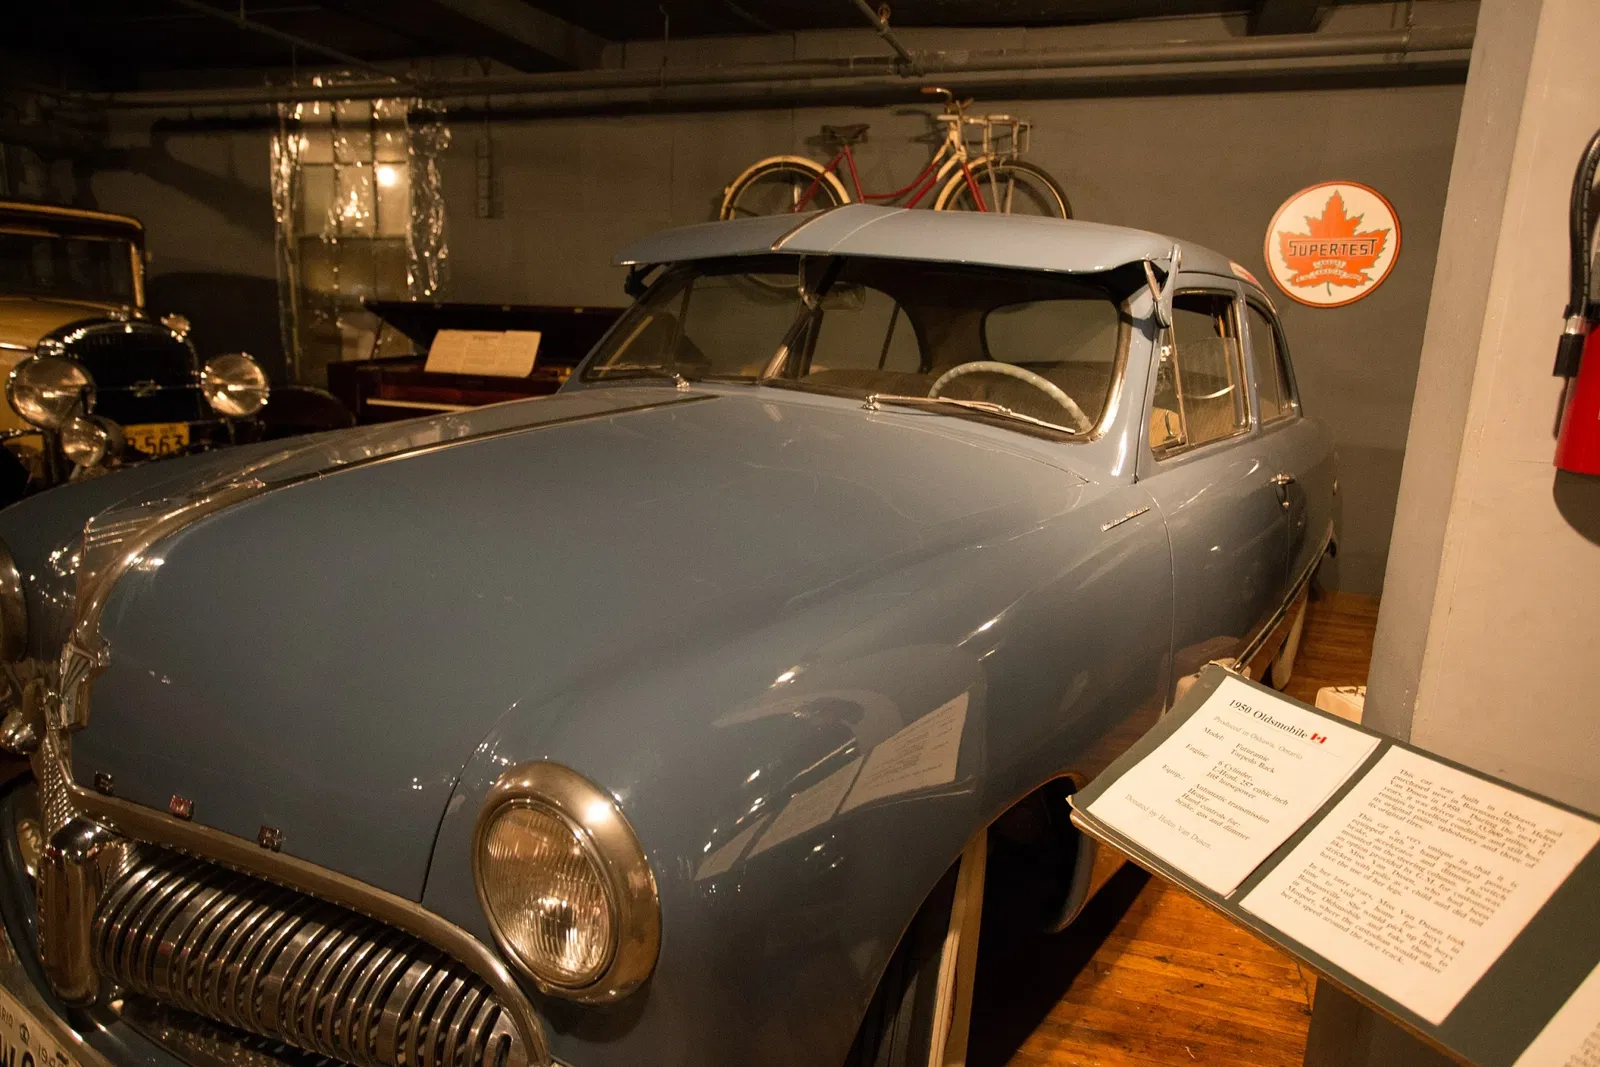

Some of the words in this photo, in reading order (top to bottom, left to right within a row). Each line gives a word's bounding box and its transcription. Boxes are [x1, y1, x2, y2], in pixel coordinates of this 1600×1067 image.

[1288, 239, 1377, 257] SUPERTEST
[1229, 699, 1252, 713] 1950
[1252, 709, 1307, 738] Oldsmobile
[1204, 726, 1224, 741] Model:
[1213, 716, 1242, 732] Produced
[1278, 746, 1302, 759] Ontario
[1185, 743, 1209, 758] Engine:
[1230, 748, 1256, 764] Torpedo
[1257, 761, 1274, 773] Back
[1235, 743, 1269, 761] Futuramic
[1187, 787, 1209, 801] Heater
[1218, 777, 1256, 798] horsepower
[1239, 779, 1253, 787] 257
[1252, 787, 1271, 797] cubic
[1272, 794, 1288, 805] inch
[1181, 792, 1200, 805] Hand
[1199, 804, 1226, 819] controls
[1226, 817, 1240, 827] for:
[1194, 783, 1226, 802] Automatic
[1227, 800, 1269, 823] transmission
[1125, 794, 1149, 811] Donated
[1149, 809, 1157, 817] by
[1158, 814, 1175, 828] Helen
[1178, 825, 1189, 836] Van
[1208, 817, 1223, 826] and
[1222, 825, 1250, 840] dimmer
[1321, 896, 1360, 919] Oldsmobile
